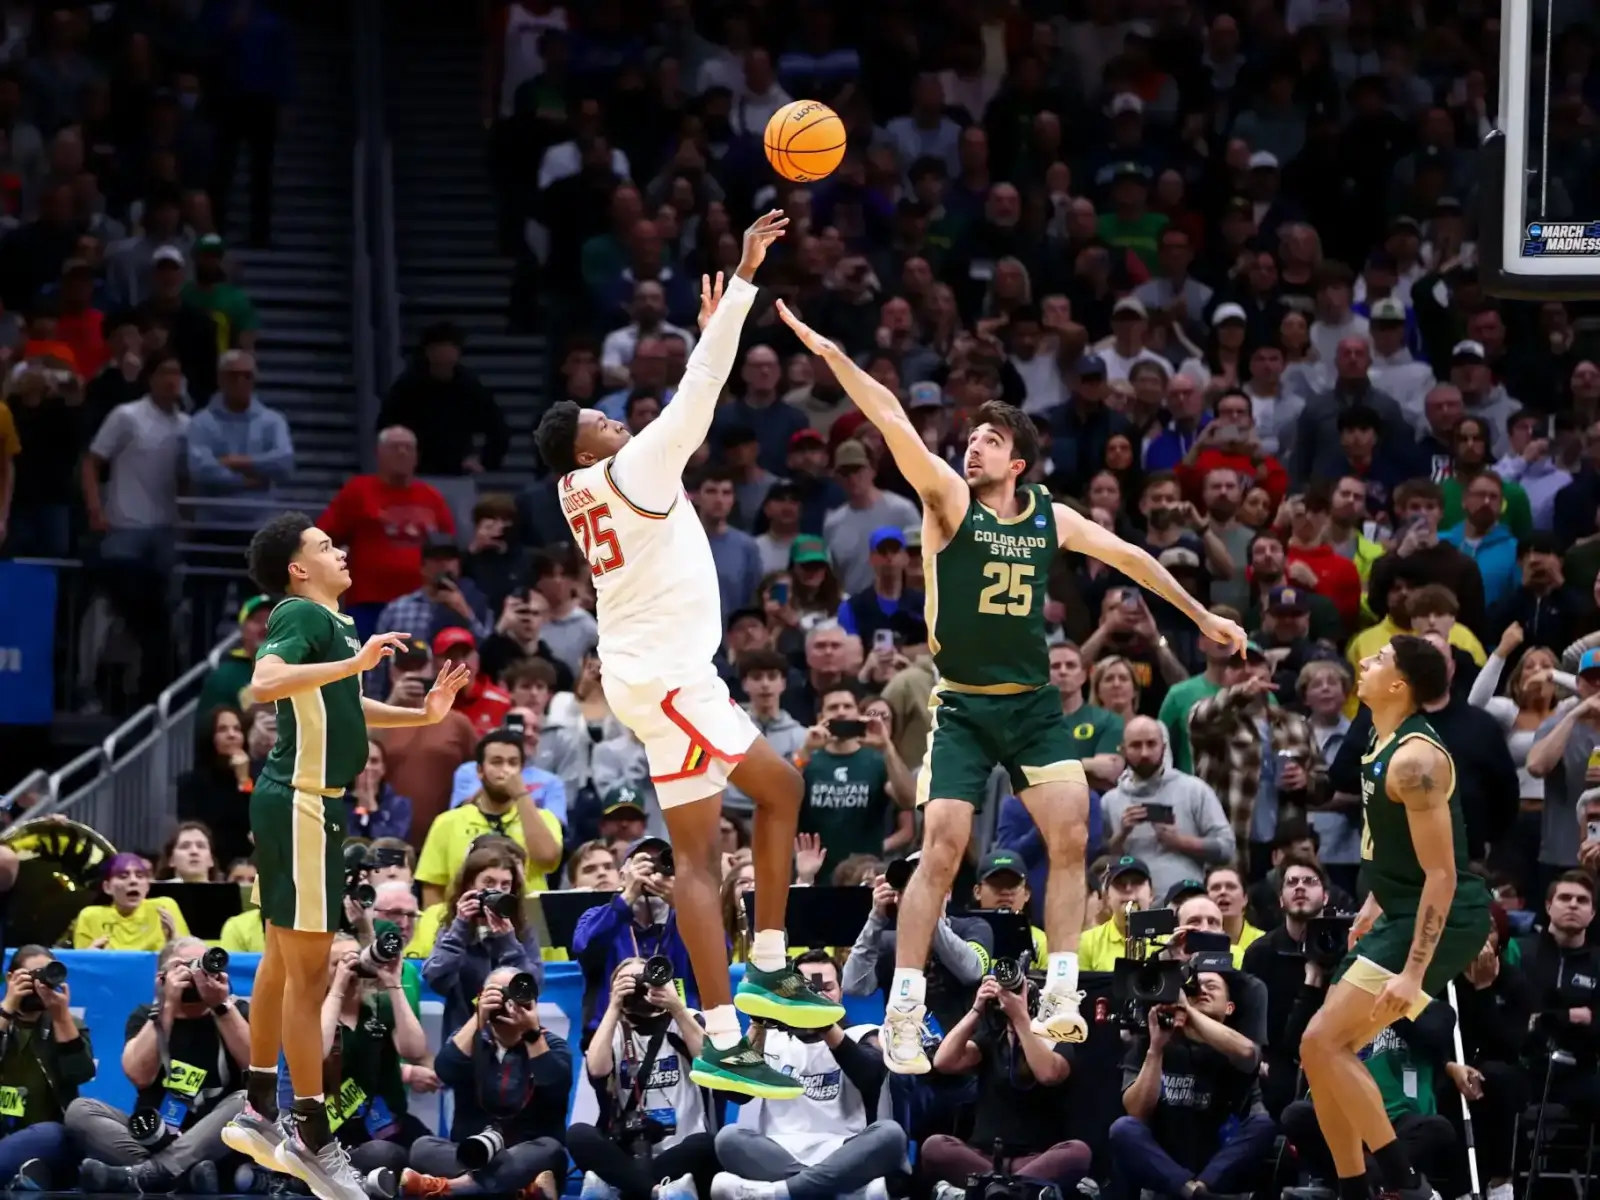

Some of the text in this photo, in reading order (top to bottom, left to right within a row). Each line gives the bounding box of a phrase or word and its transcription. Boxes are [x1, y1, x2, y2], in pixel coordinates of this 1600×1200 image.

[1541, 225, 1585, 238] MARCH
[1545, 238, 1600, 251] MADNESS
[562, 487, 596, 514] QUEEN
[569, 502, 625, 578] 25
[974, 529, 1046, 549] COLORADO
[990, 543, 1031, 559] STATE
[978, 561, 1035, 617] 25
[811, 784, 869, 795] SPARTAN
[810, 794, 869, 809] NATION
